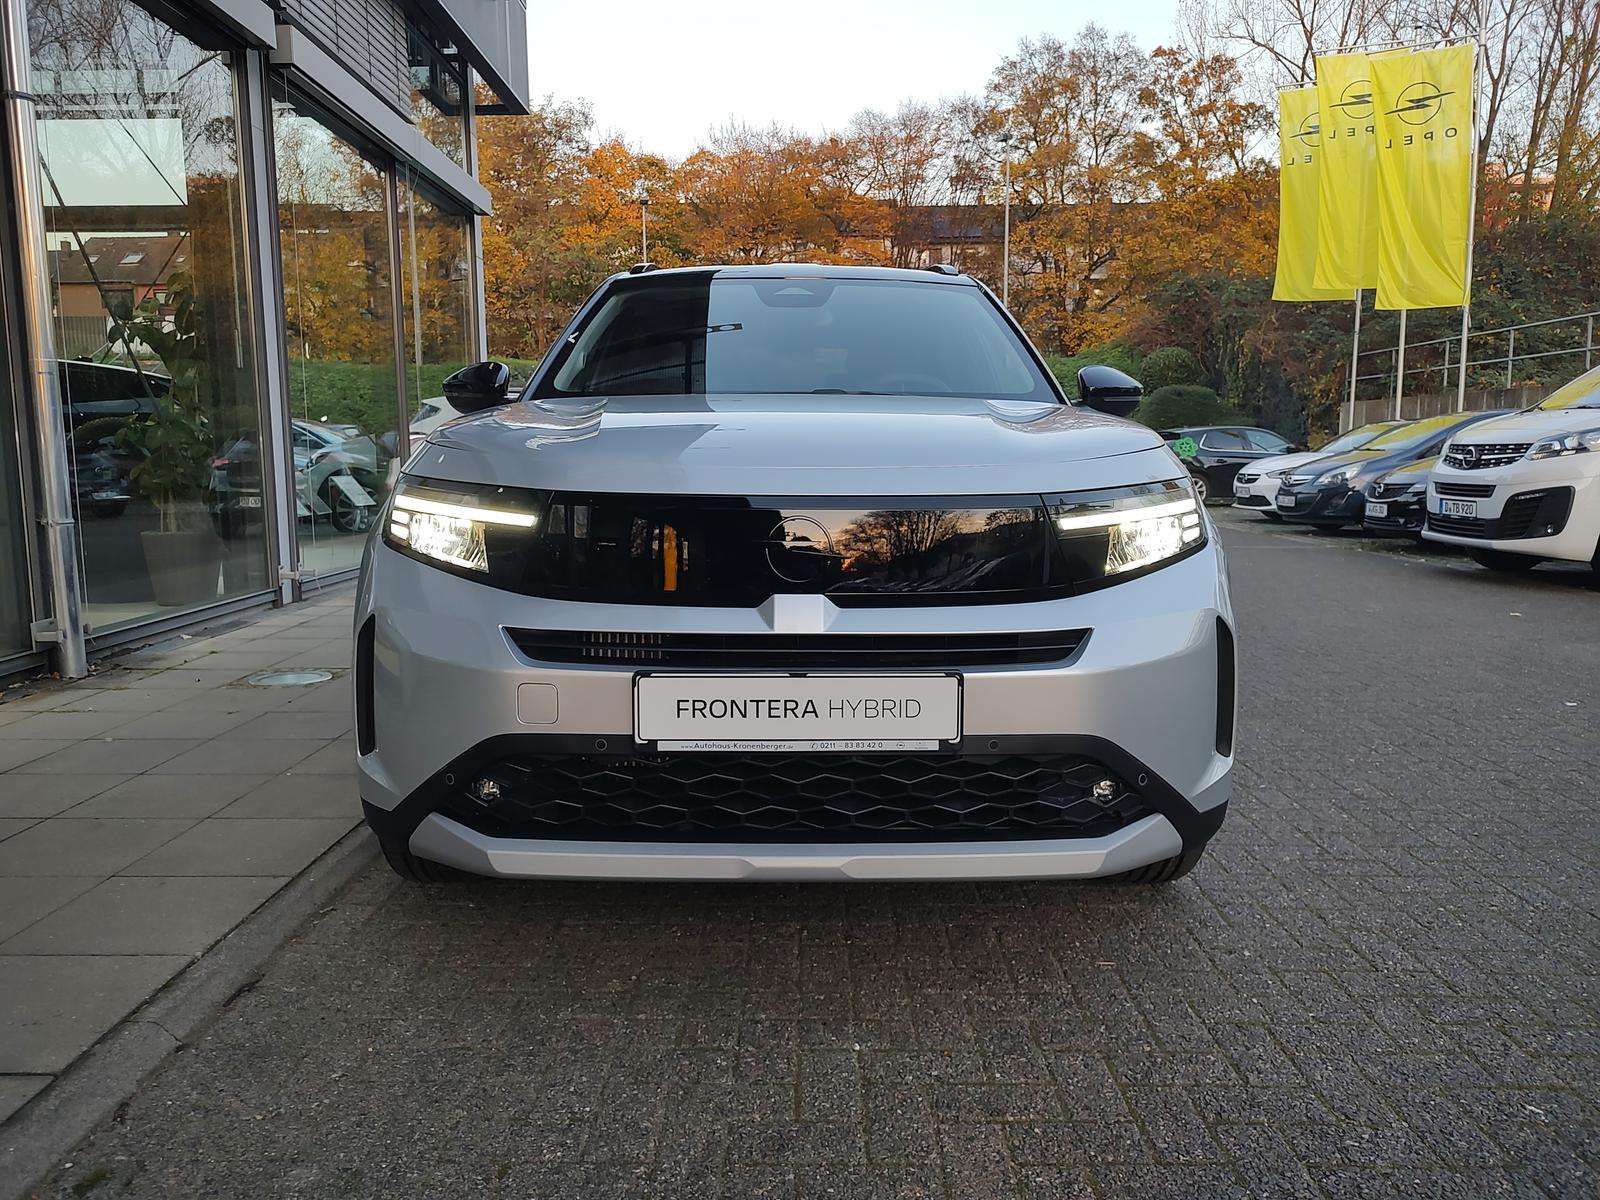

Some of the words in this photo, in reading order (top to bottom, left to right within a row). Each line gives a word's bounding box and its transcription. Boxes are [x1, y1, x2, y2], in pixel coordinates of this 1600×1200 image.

[676, 699, 819, 719] FRONTERA
[828, 699, 922, 719] HYBRID
[819, 742, 836, 750] 0211
[844, 742, 854, 750] 83
